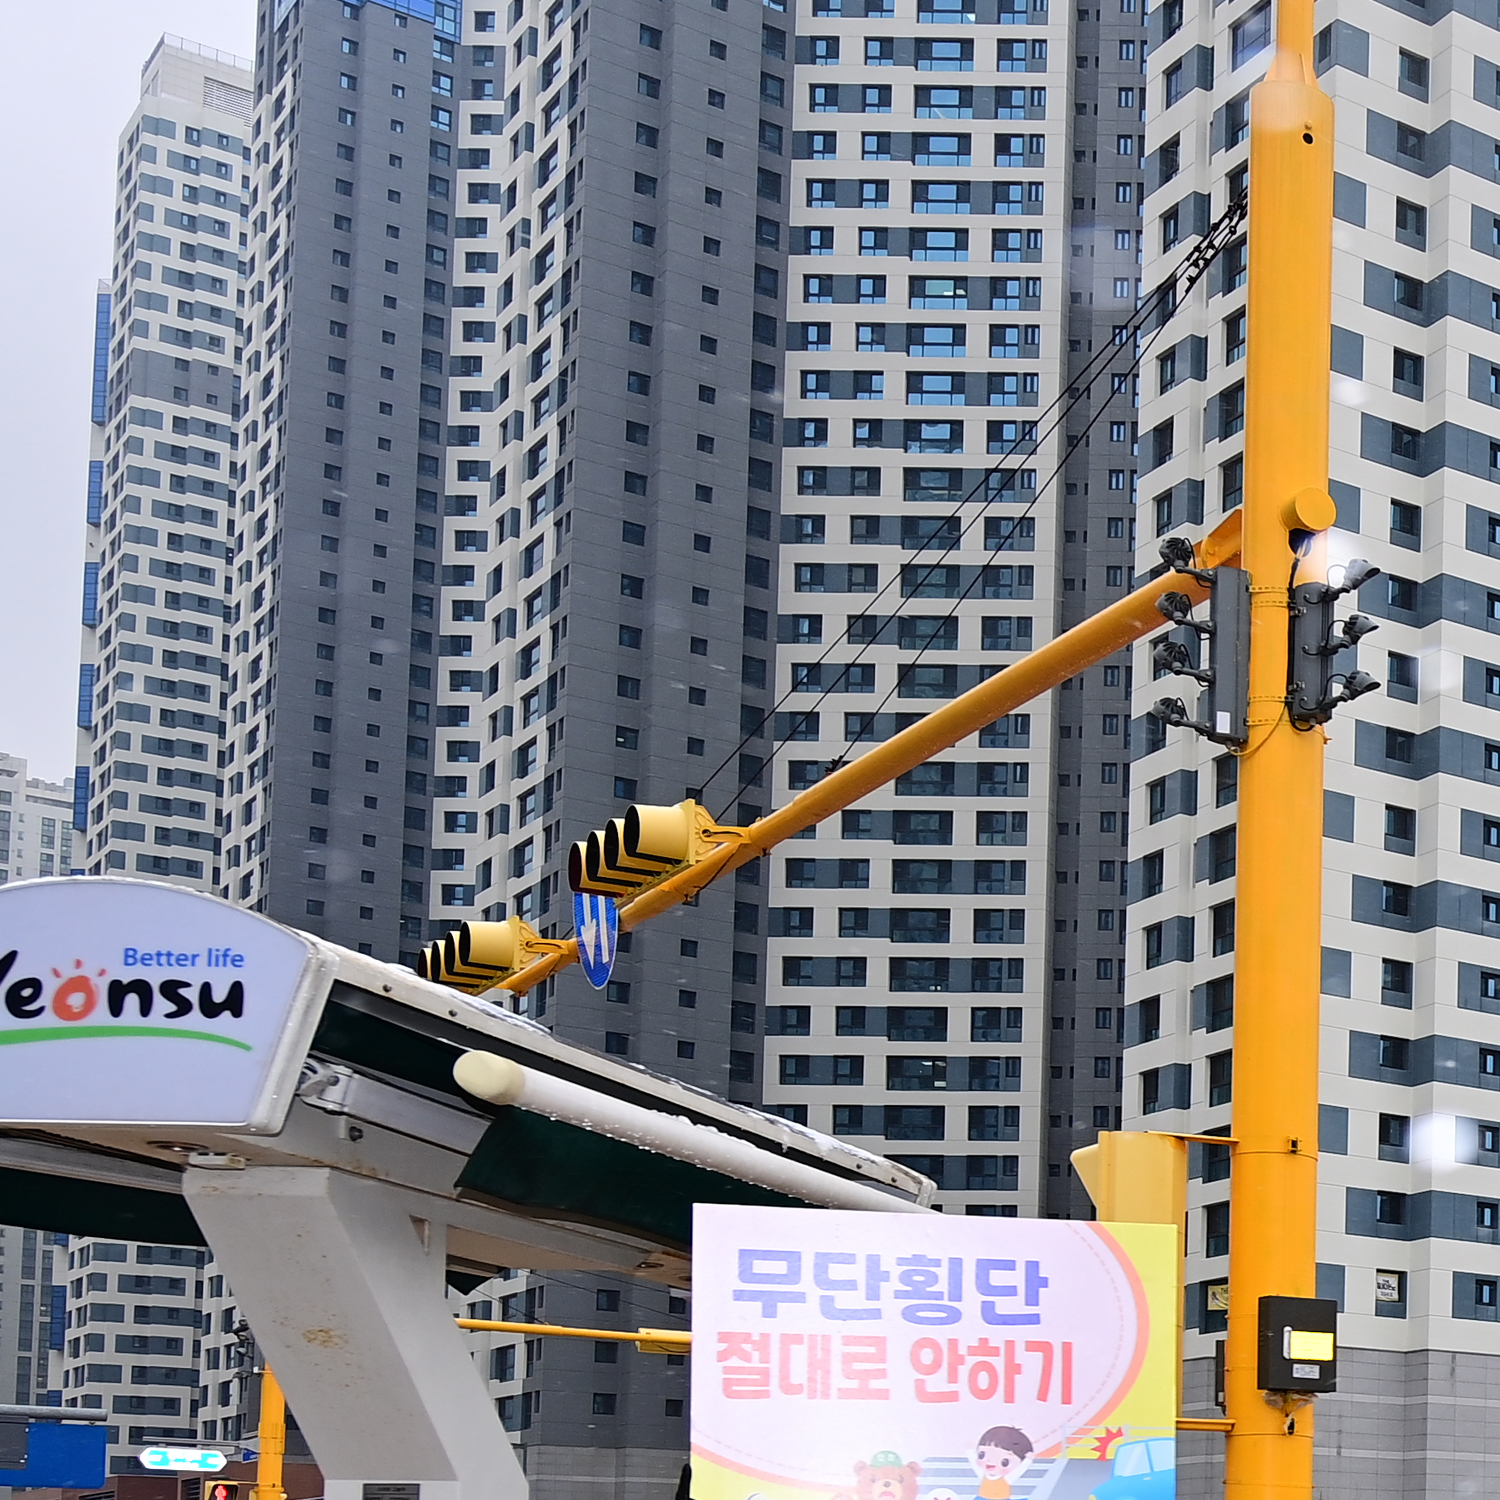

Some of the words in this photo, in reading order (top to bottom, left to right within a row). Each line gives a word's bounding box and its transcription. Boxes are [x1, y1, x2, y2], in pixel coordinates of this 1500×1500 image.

[123, 948, 200, 967] Better
[207, 948, 244, 967] life
[732, 1248, 1049, 1325] 무단횡단
[716, 1332, 889, 1402] 절대로
[911, 1337, 1072, 1405] 안하기
